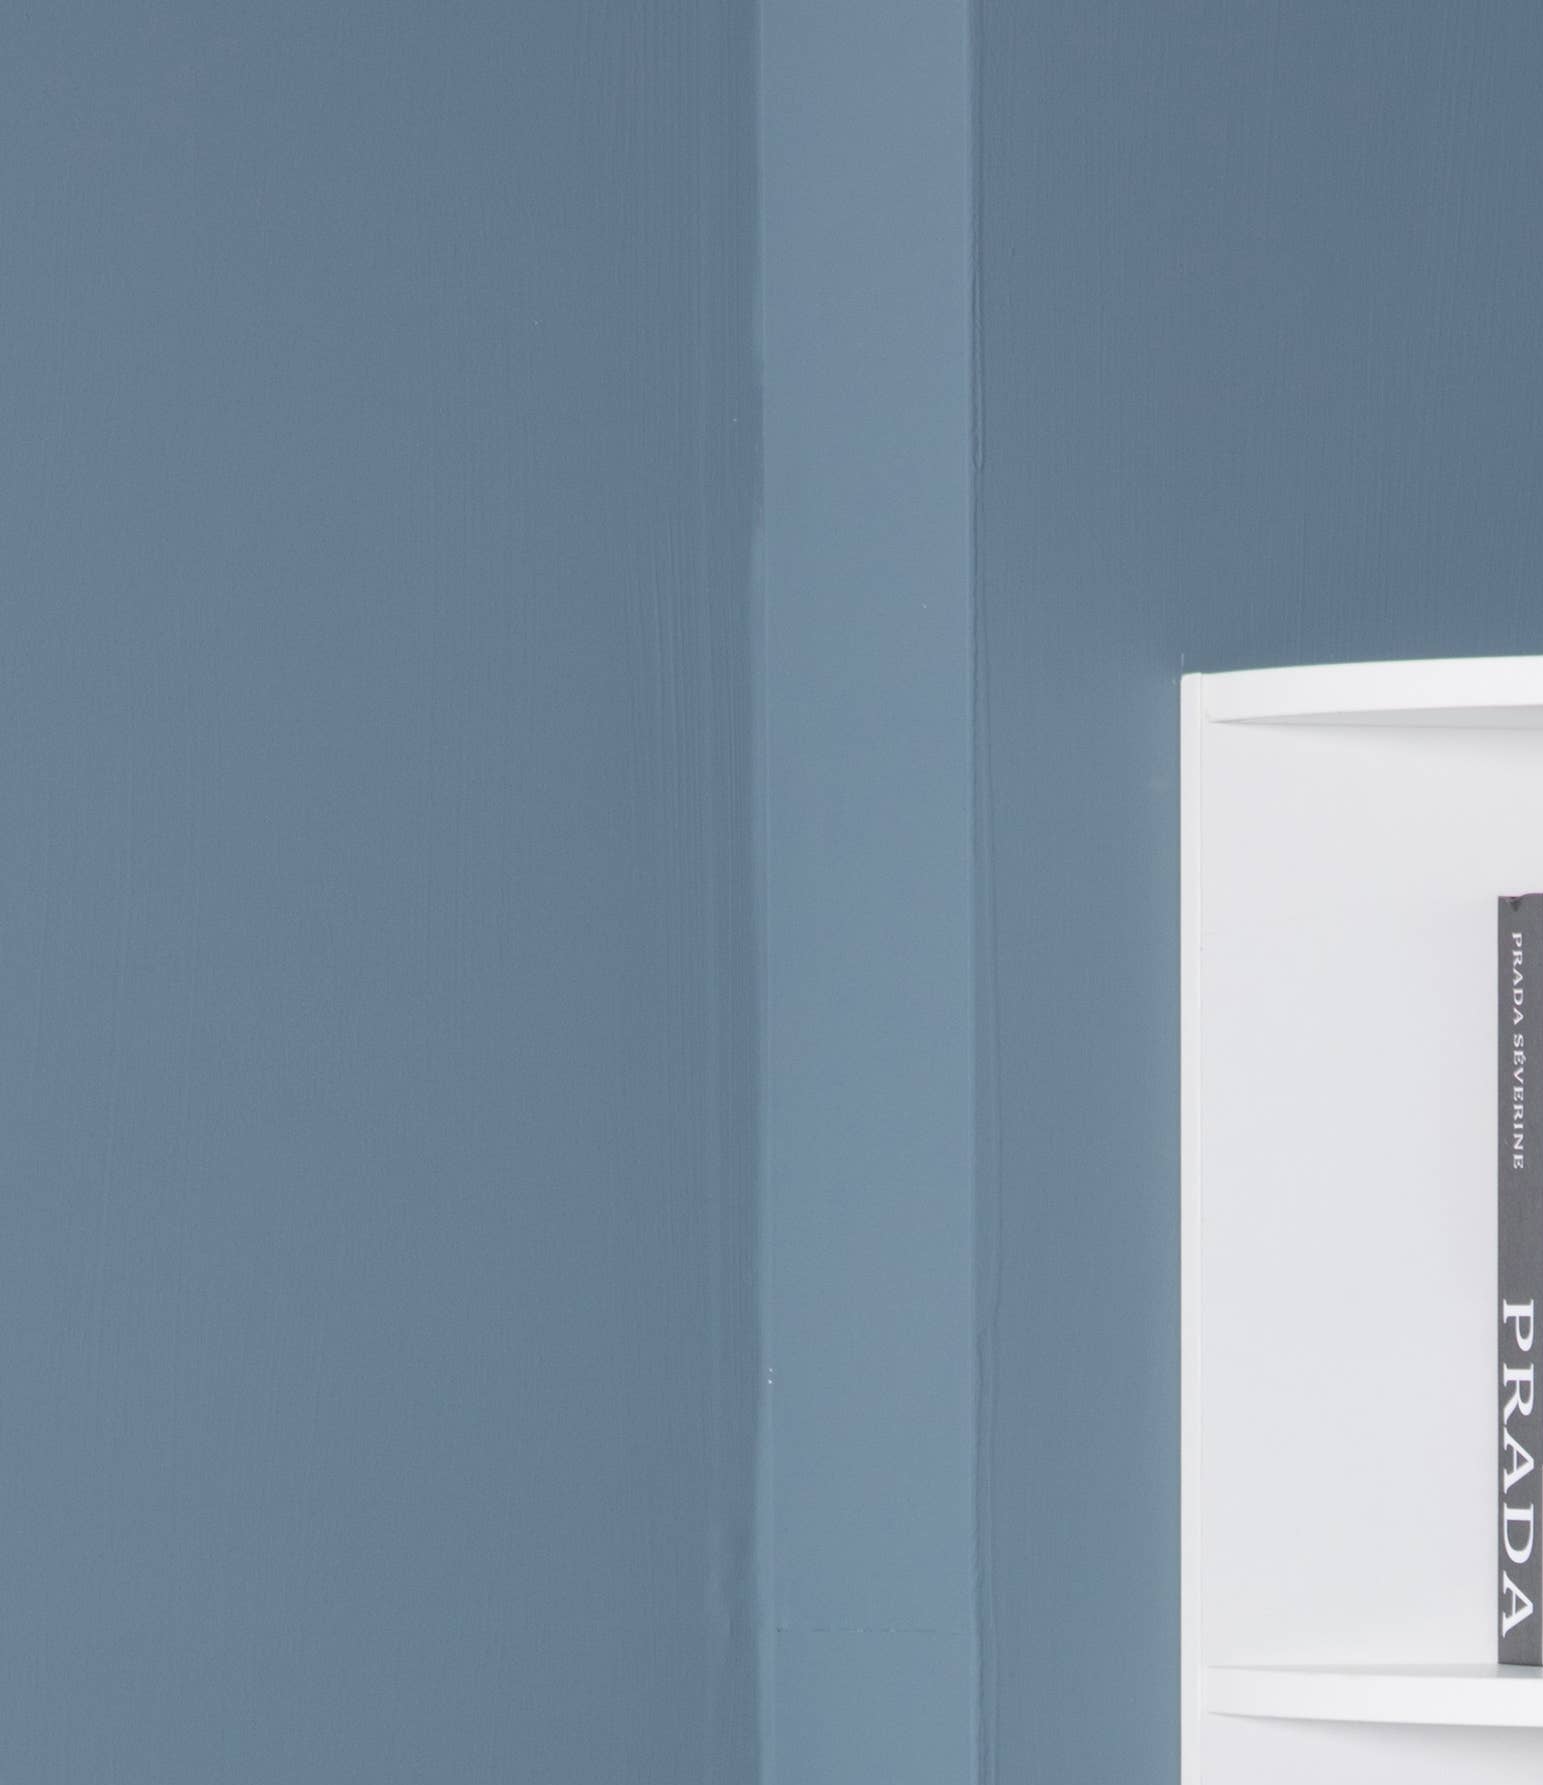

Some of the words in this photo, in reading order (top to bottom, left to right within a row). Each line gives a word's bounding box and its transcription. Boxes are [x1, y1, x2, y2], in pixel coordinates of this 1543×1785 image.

[1511, 931, 1525, 1026] PRADA
[1512, 1032, 1526, 1170] SÉVERINE
[1502, 1299, 1535, 1639] PRADA
